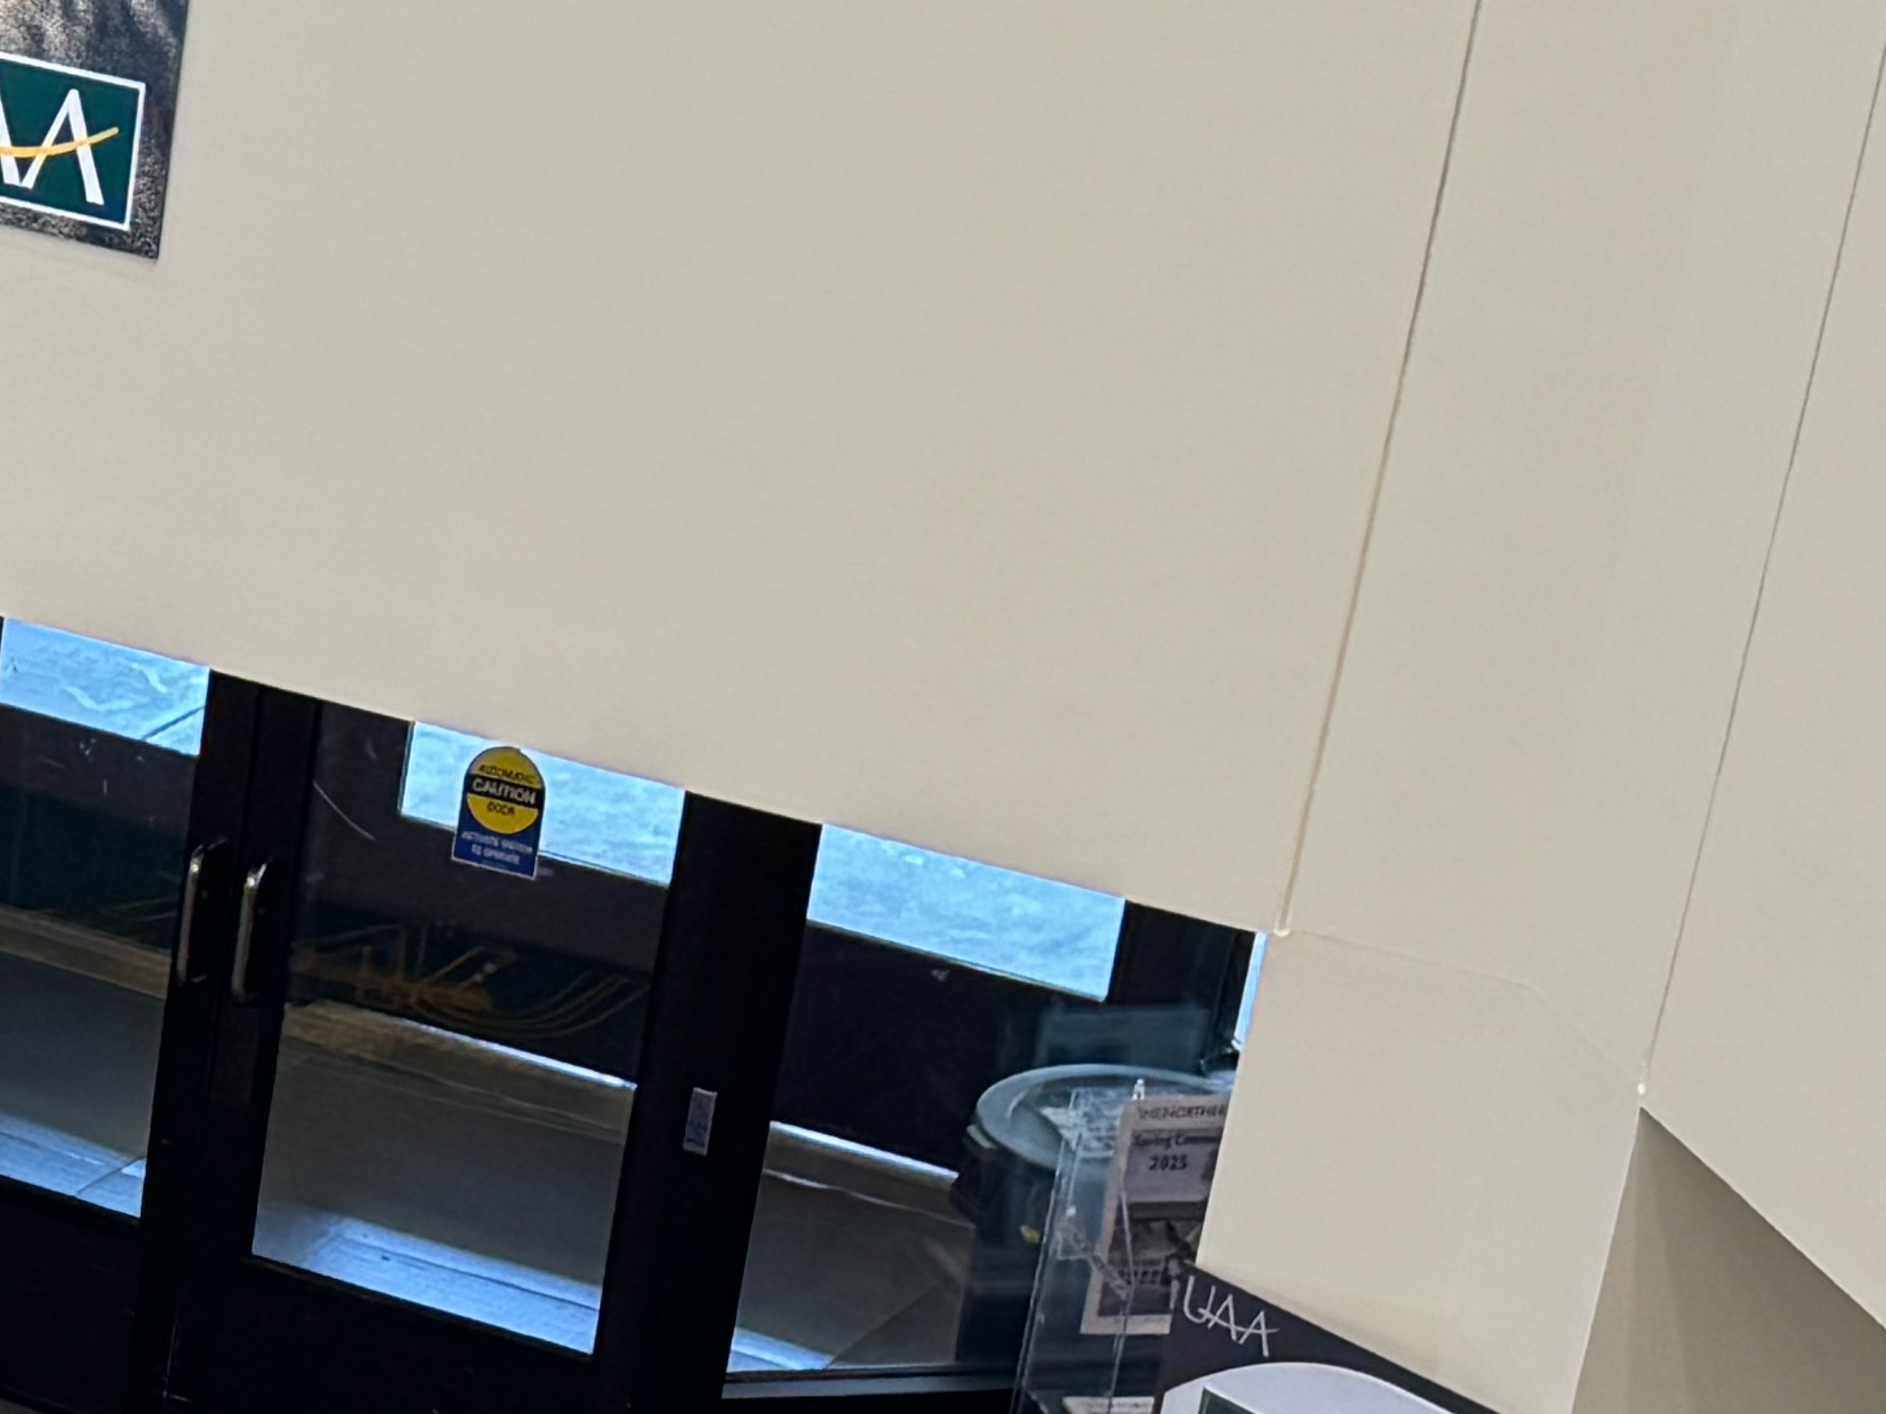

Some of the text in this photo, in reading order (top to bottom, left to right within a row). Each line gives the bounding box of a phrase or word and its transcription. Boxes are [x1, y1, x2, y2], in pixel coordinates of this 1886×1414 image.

[472, 778, 537, 805] CAUTION
[1149, 1154, 1188, 1171] 2025
[1183, 1274, 1271, 1357] UAA
